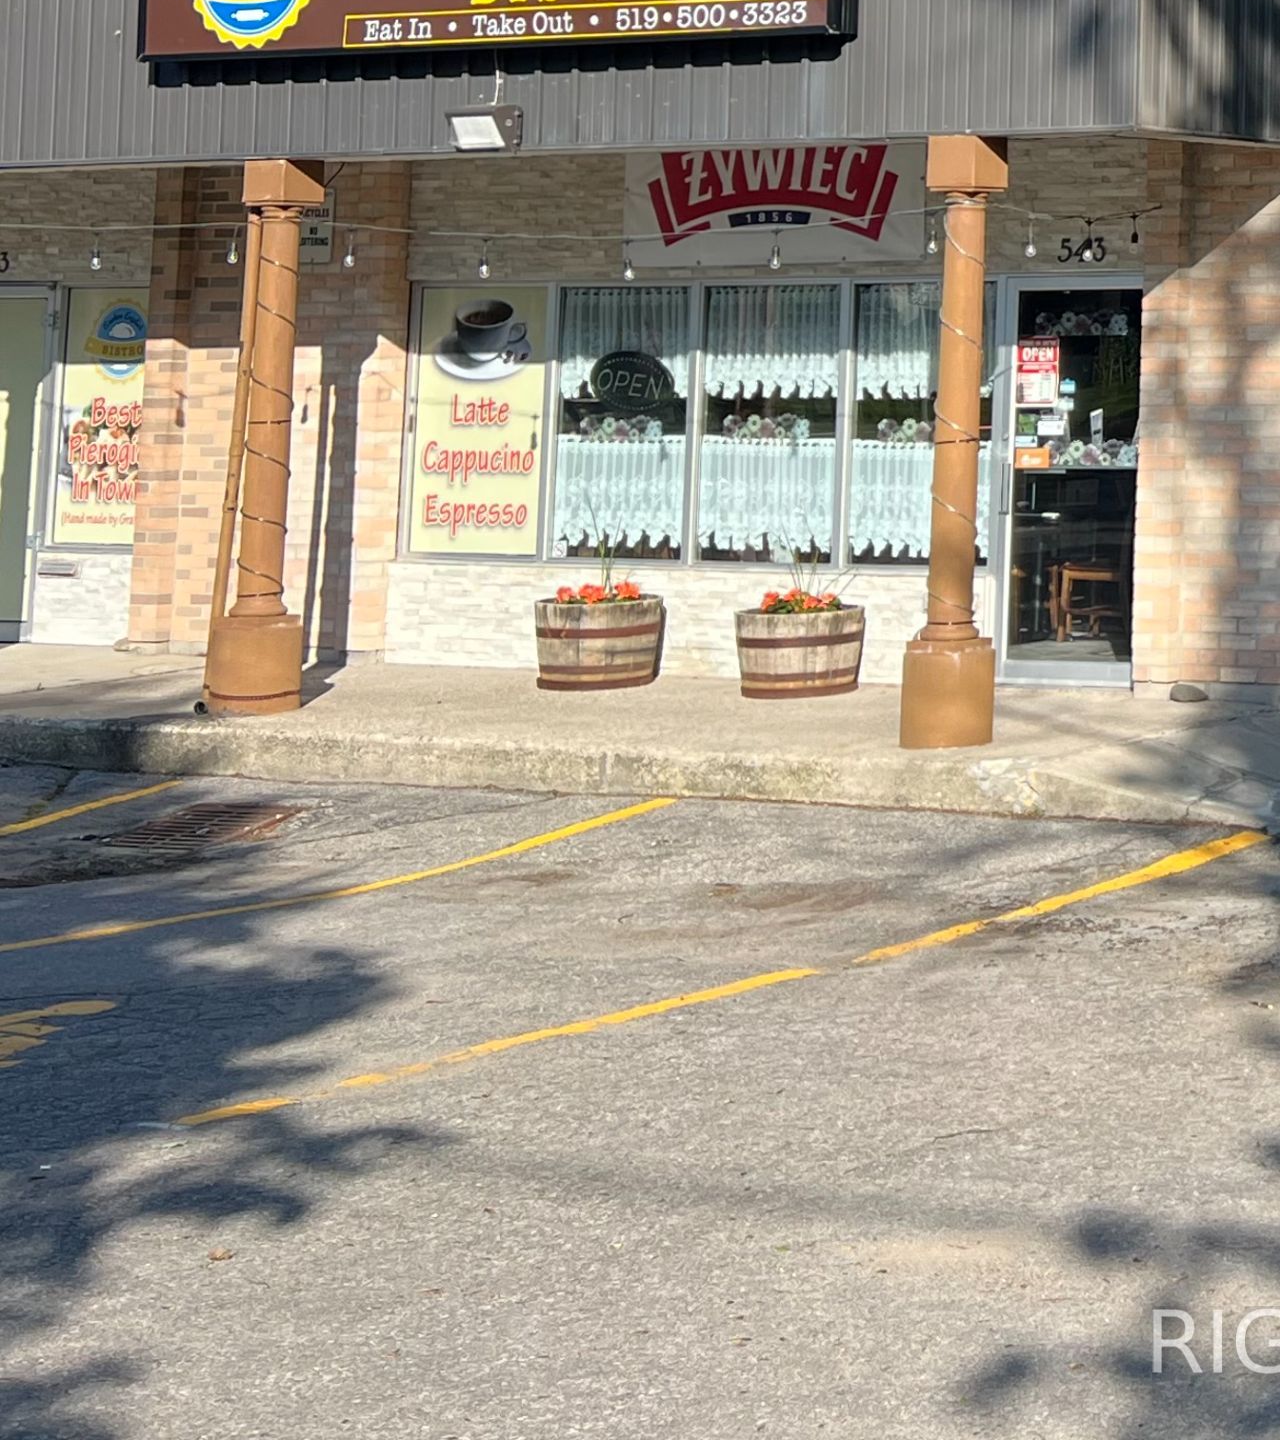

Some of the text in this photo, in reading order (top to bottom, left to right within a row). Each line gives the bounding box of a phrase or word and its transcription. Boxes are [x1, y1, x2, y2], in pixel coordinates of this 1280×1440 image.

[364, 19, 402, 41] Eat
[408, 18, 432, 40] In
[472, 13, 527, 36] Take
[532, 11, 574, 34] Out
[1057, 237, 1106, 262] 543
[102, 344, 144, 357] BISTRO
[1022, 347, 1055, 362] OPEN
[597, 368, 666, 399] OPEN
[92, 397, 141, 426] Best
[452, 393, 511, 424] Latte
[423, 441, 535, 482] Cappucino
[74, 472, 89, 500] In
[424, 494, 527, 536] Espresso
